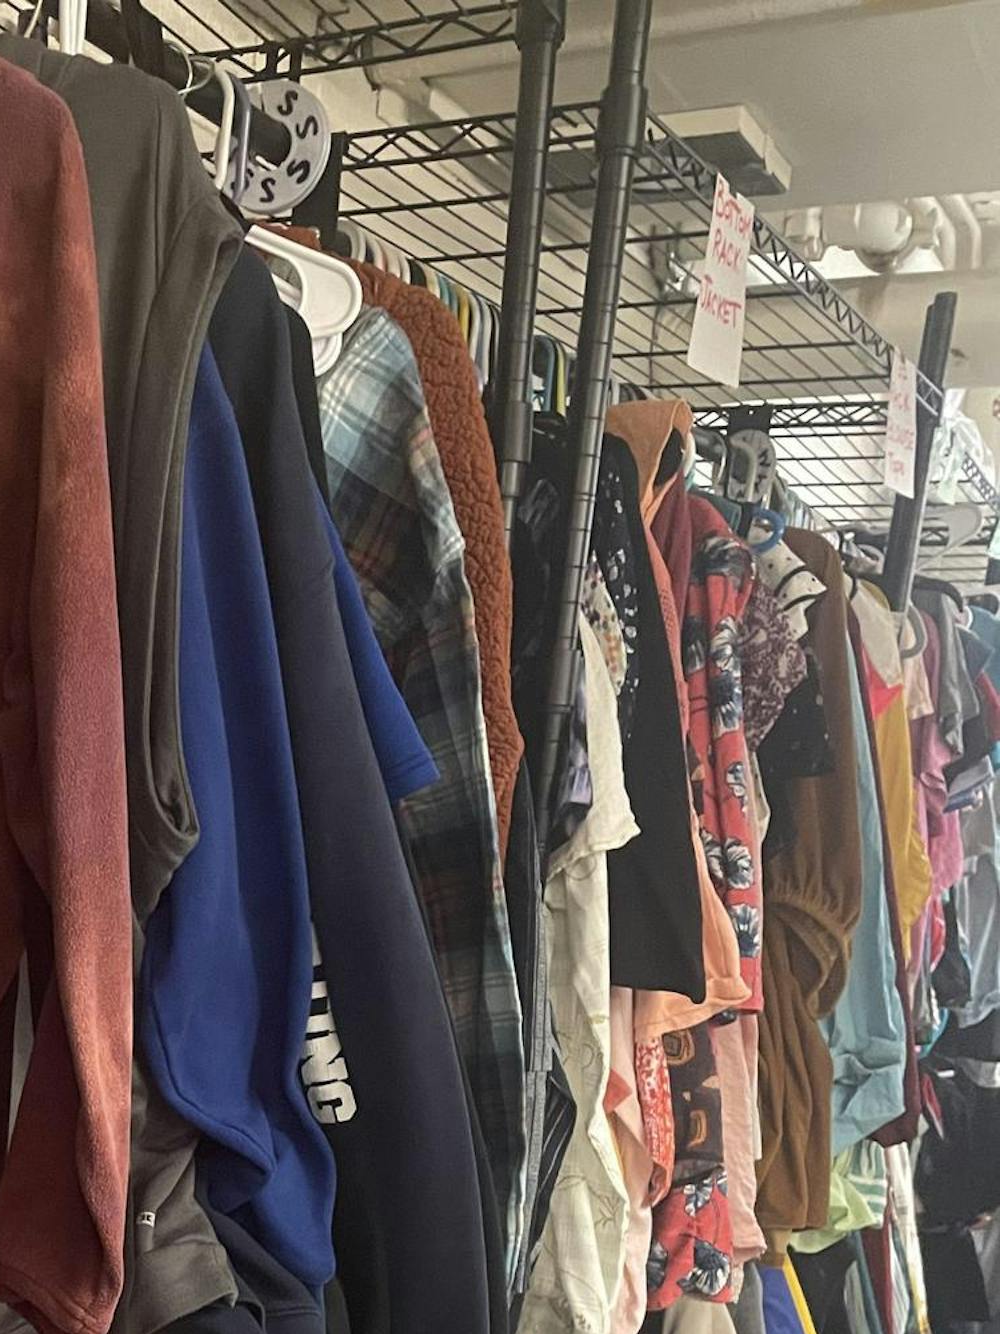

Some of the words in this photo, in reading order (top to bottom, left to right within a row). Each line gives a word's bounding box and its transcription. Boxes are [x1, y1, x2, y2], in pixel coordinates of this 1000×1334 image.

[277, 90, 298, 115] S
[296, 115, 318, 139] S
[287, 159, 310, 183] S
[260, 177, 276, 203] S
[713, 229, 741, 270] RACK
[701, 275, 741, 328] JACKET
